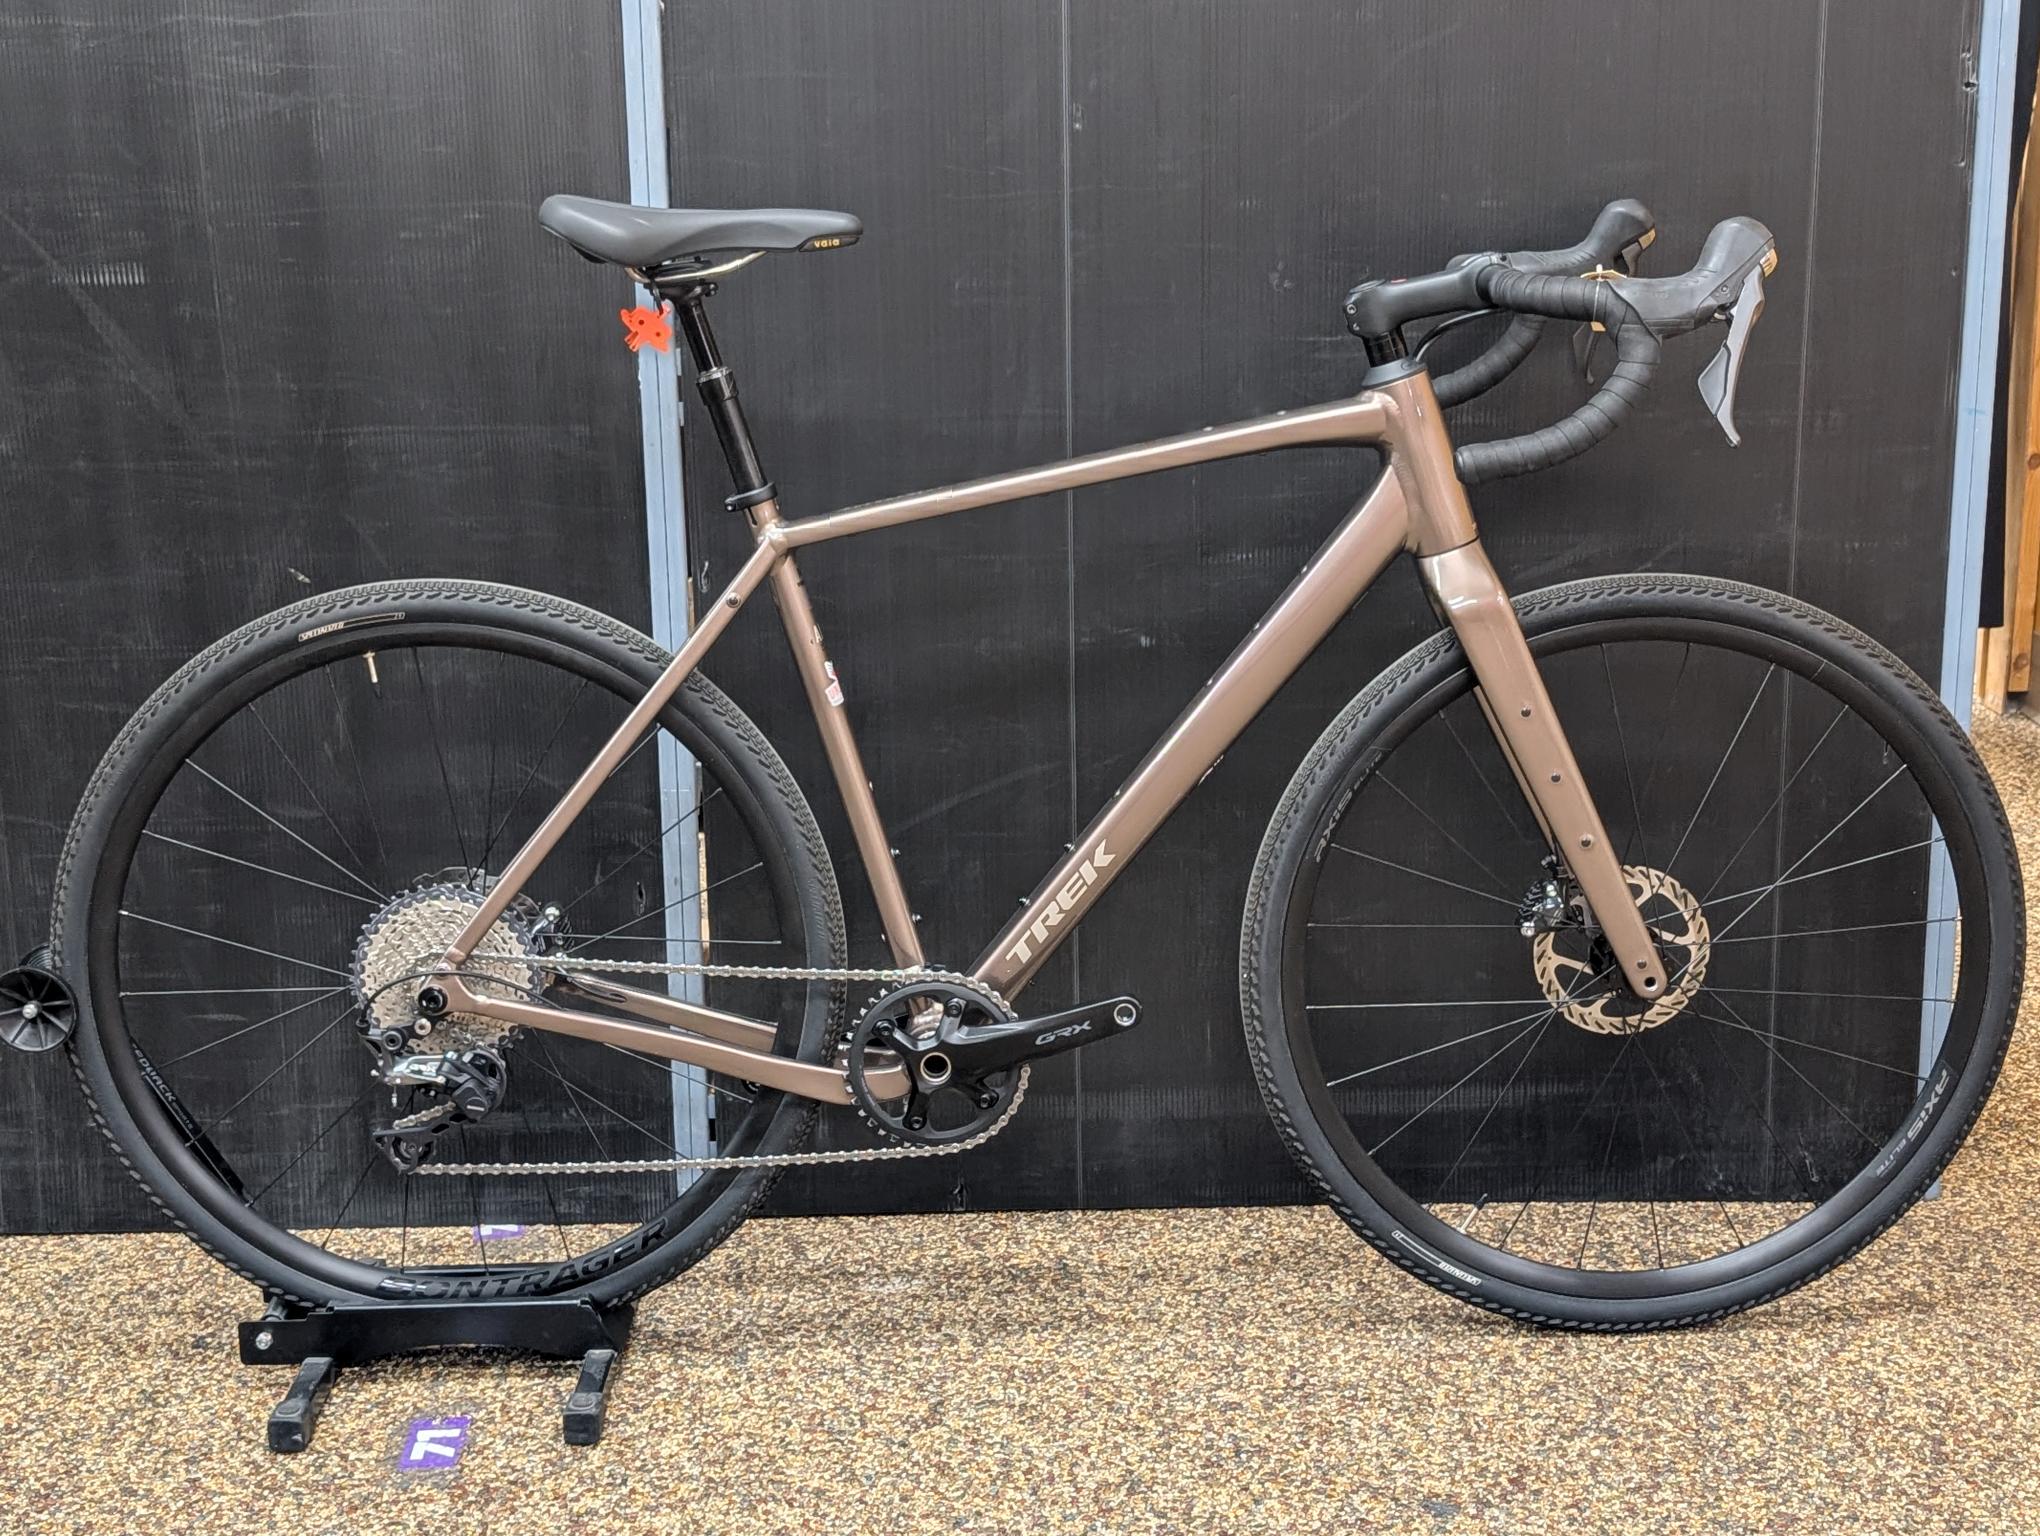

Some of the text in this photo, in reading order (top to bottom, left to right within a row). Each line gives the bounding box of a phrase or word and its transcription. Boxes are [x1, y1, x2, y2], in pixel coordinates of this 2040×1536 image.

[1005, 838, 1116, 964] TREK
[1035, 1020, 1092, 1046] GRX
[1906, 1068, 1951, 1143] AXIS
